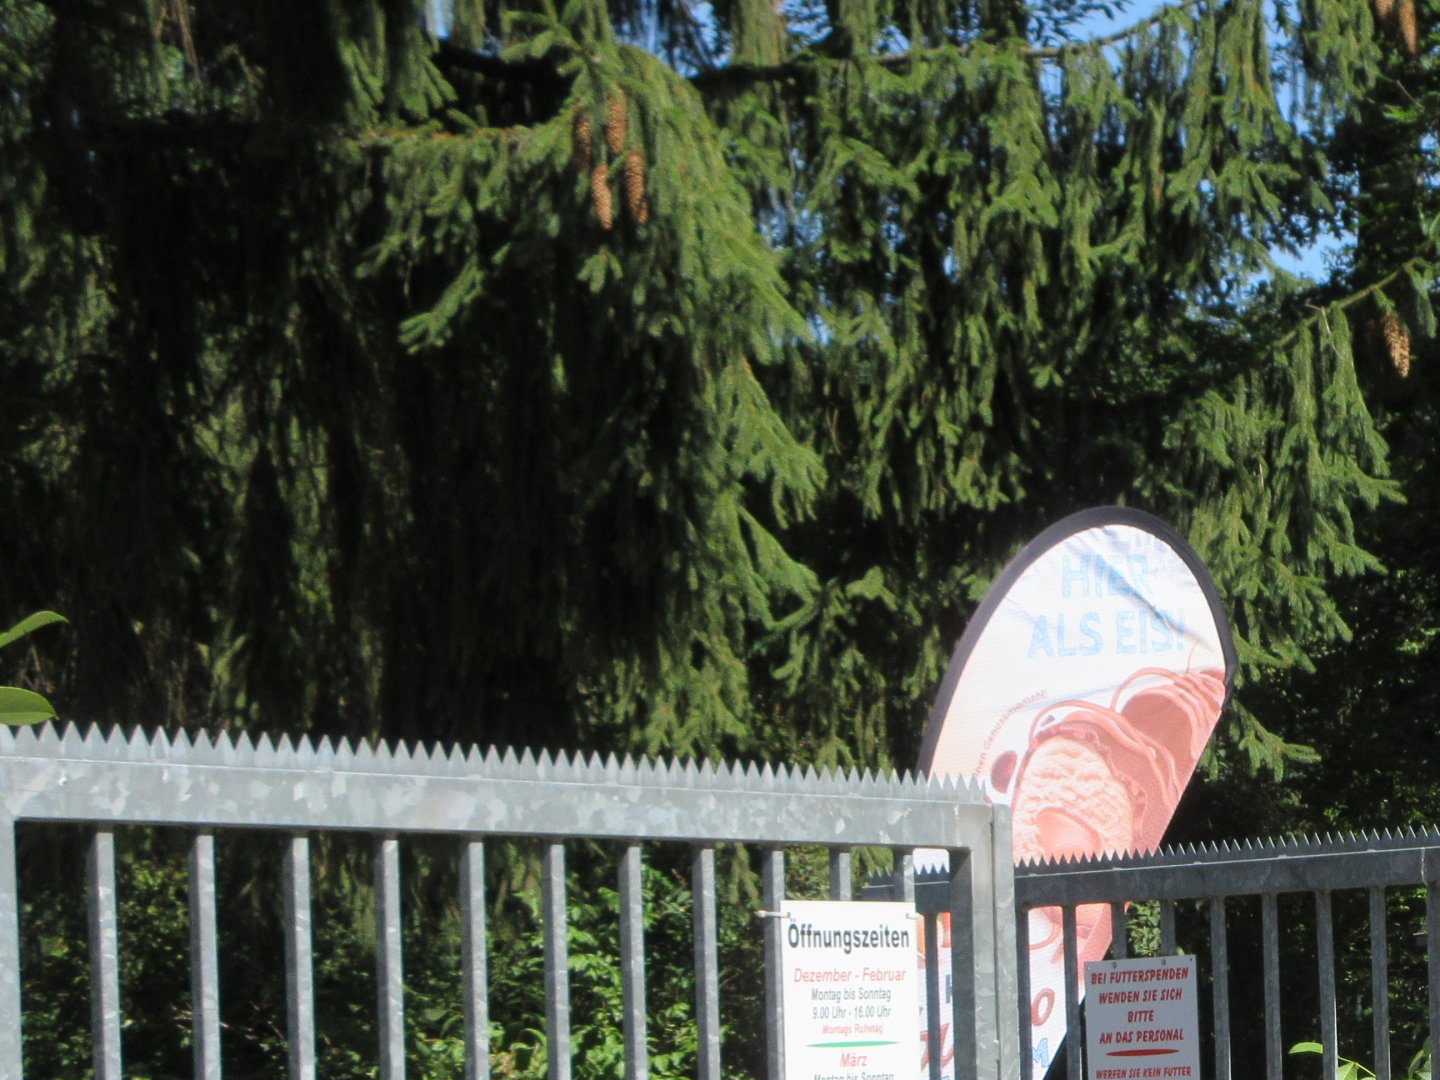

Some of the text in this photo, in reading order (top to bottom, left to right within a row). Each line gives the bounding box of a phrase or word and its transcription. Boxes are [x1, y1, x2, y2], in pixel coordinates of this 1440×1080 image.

[1061, 553, 1150, 598] HIER
[1027, 609, 1185, 659] ALS EIS!
[788, 918, 910, 954] Öffnungszeiten
[794, 968, 852, 982] Dezember
[862, 967, 906, 981] Februar
[1091, 967, 1189, 985] BEI FUTTERSPENDEN
[811, 987, 891, 1003] Montag bis Sonntag
[1099, 988, 1183, 1004] WENDEN SIE SICH
[813, 1007, 830, 1019] 9.00
[832, 1006, 847, 1019] Uhr
[854, 1005, 875, 1018] 16.00
[877, 1005, 892, 1018] Uhr
[1127, 1010, 1155, 1023] BITTE
[822, 1023, 883, 1036] Montags Ruhetag
[1099, 1028, 1184, 1045] AN DAS PERSONAL
[840, 1052, 868, 1067] März
[1095, 1066, 1192, 1080] WERFEN SIE KEIN FUTTER
